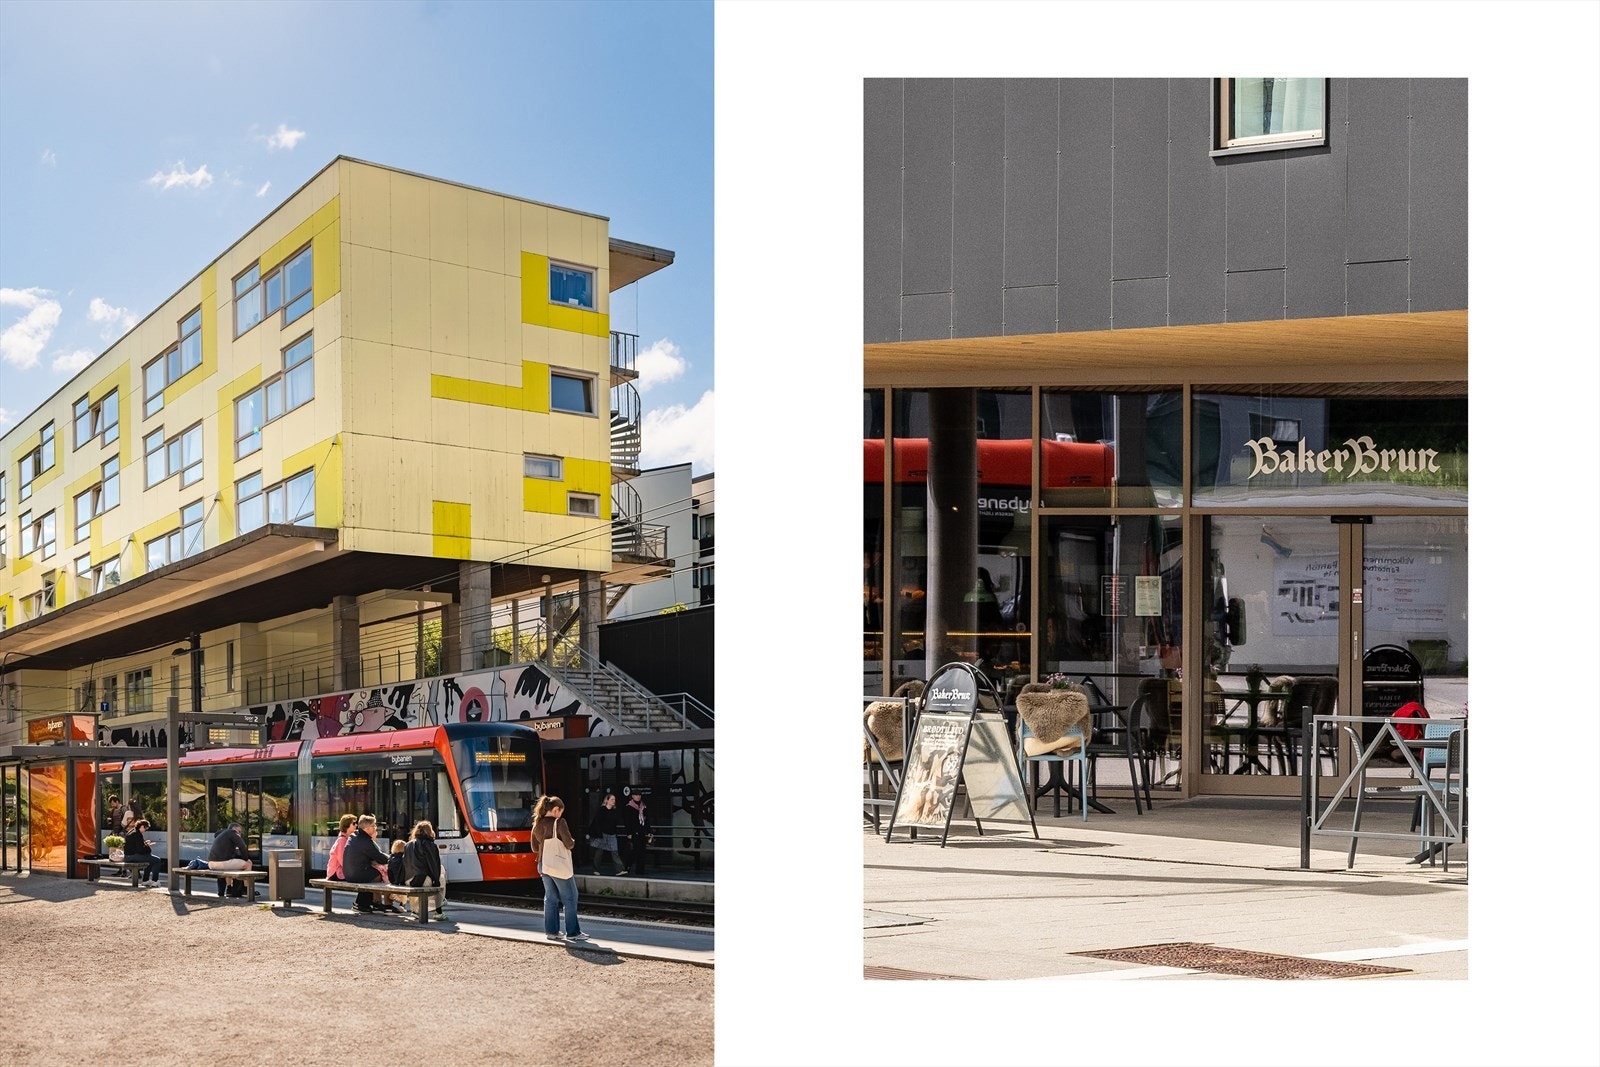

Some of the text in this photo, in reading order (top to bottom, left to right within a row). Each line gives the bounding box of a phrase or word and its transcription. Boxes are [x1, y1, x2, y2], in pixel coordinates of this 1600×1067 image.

[1244, 435, 1440, 479] BakerBrun
[931, 687, 971, 701] BakerBrun
[534, 722, 561, 731] bybanen
[391, 755, 413, 764] bybanen
[449, 843, 460, 851] 234
